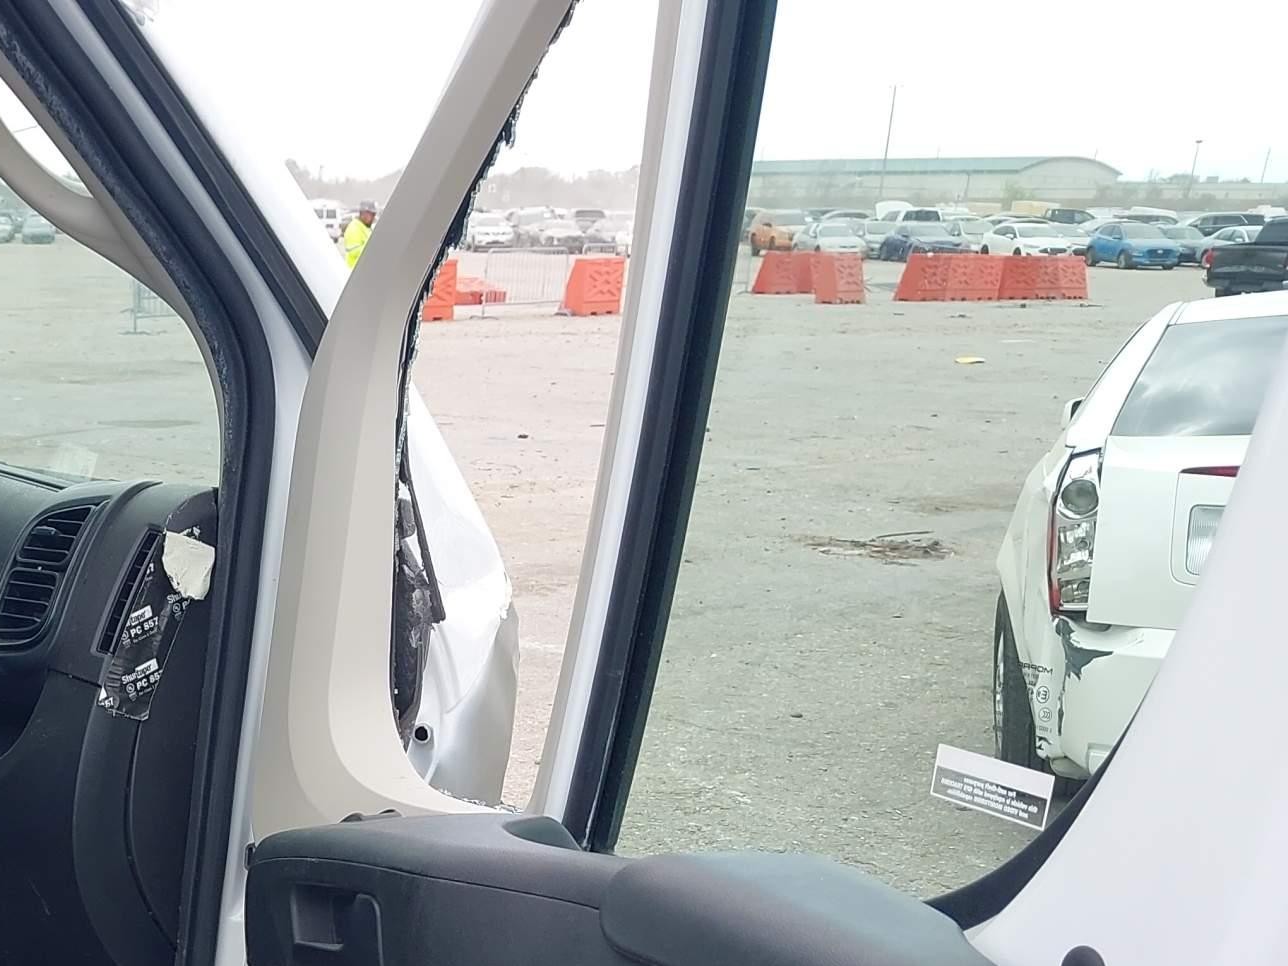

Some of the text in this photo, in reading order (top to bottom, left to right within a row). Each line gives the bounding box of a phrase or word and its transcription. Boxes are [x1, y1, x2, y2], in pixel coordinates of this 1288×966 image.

[130, 625, 142, 637] PC
[143, 616, 159, 631] 857
[136, 678, 148, 690] PC
